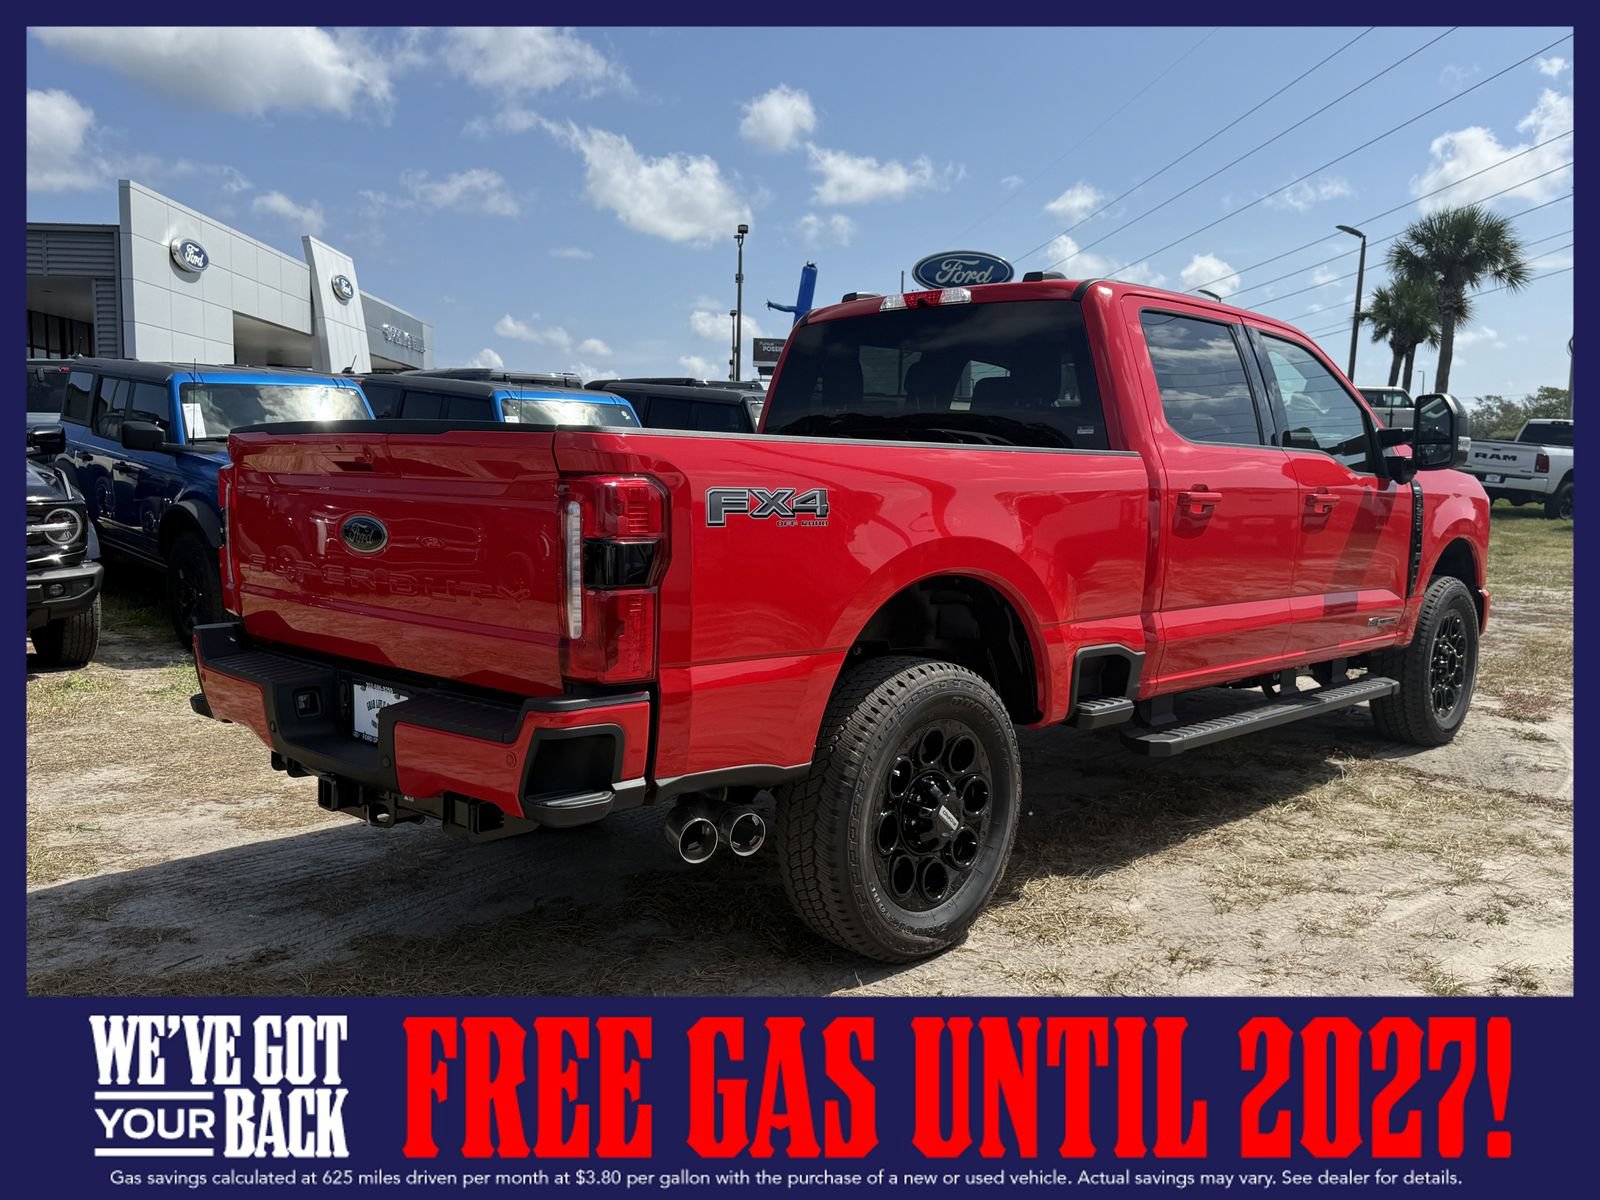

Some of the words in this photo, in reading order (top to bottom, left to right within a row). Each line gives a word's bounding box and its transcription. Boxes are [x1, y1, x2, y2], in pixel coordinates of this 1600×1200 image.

[185, 243, 205, 267] Ford
[935, 259, 994, 284] Ford
[1474, 452, 1518, 461] RAM
[705, 487, 830, 528] FX4
[344, 521, 375, 545] Ford
[776, 519, 798, 527] OFF
[249, 552, 378, 590] SUPER
[389, 572, 531, 608] DUTY
